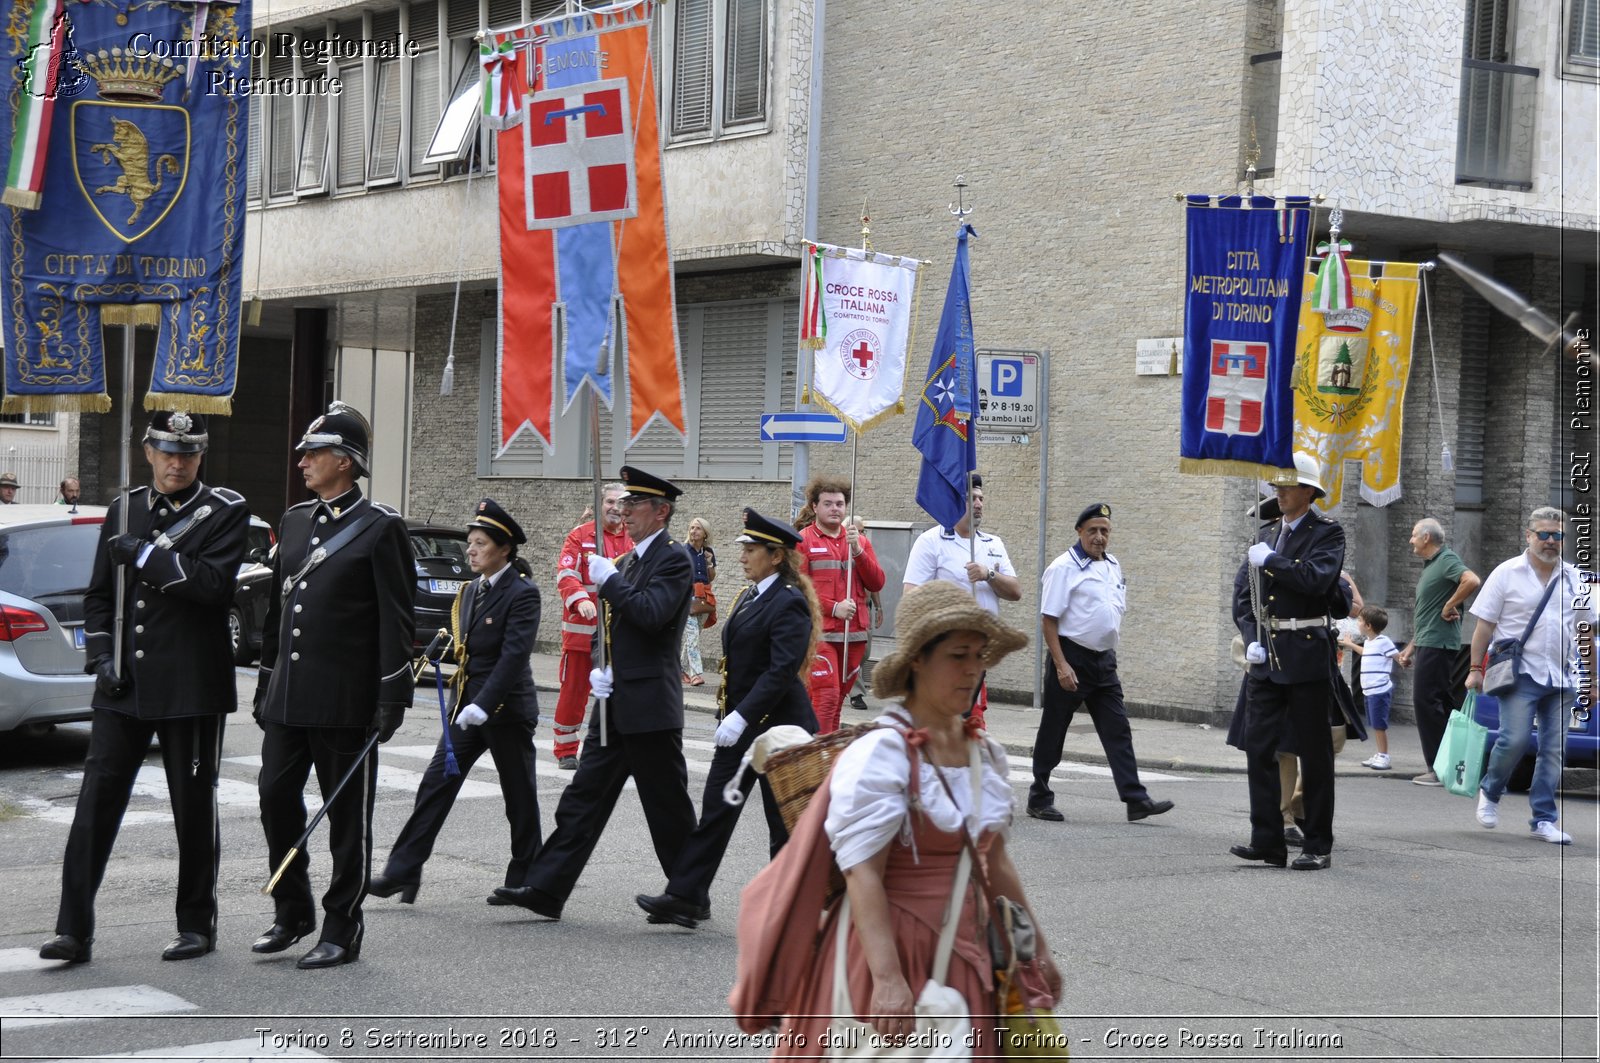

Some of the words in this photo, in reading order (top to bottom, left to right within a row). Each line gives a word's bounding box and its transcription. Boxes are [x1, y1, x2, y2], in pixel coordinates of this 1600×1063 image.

[115, 255, 134, 274] DI
[141, 256, 207, 279] TORINO
[1226, 248, 1260, 271] CITTÀ
[826, 283, 864, 298] CROCE
[868, 288, 898, 304] ROSSA
[1191, 275, 1289, 297] METROPOLITANA
[840, 299, 886, 314] ITALIANA
[1213, 301, 1224, 321] DI
[1226, 302, 1272, 323] TORINO
[833, 312, 865, 321] COMITATO
[872, 317, 890, 325] TORINO
[997, 364, 1017, 392] P
[1019, 415, 1032, 423] lati
